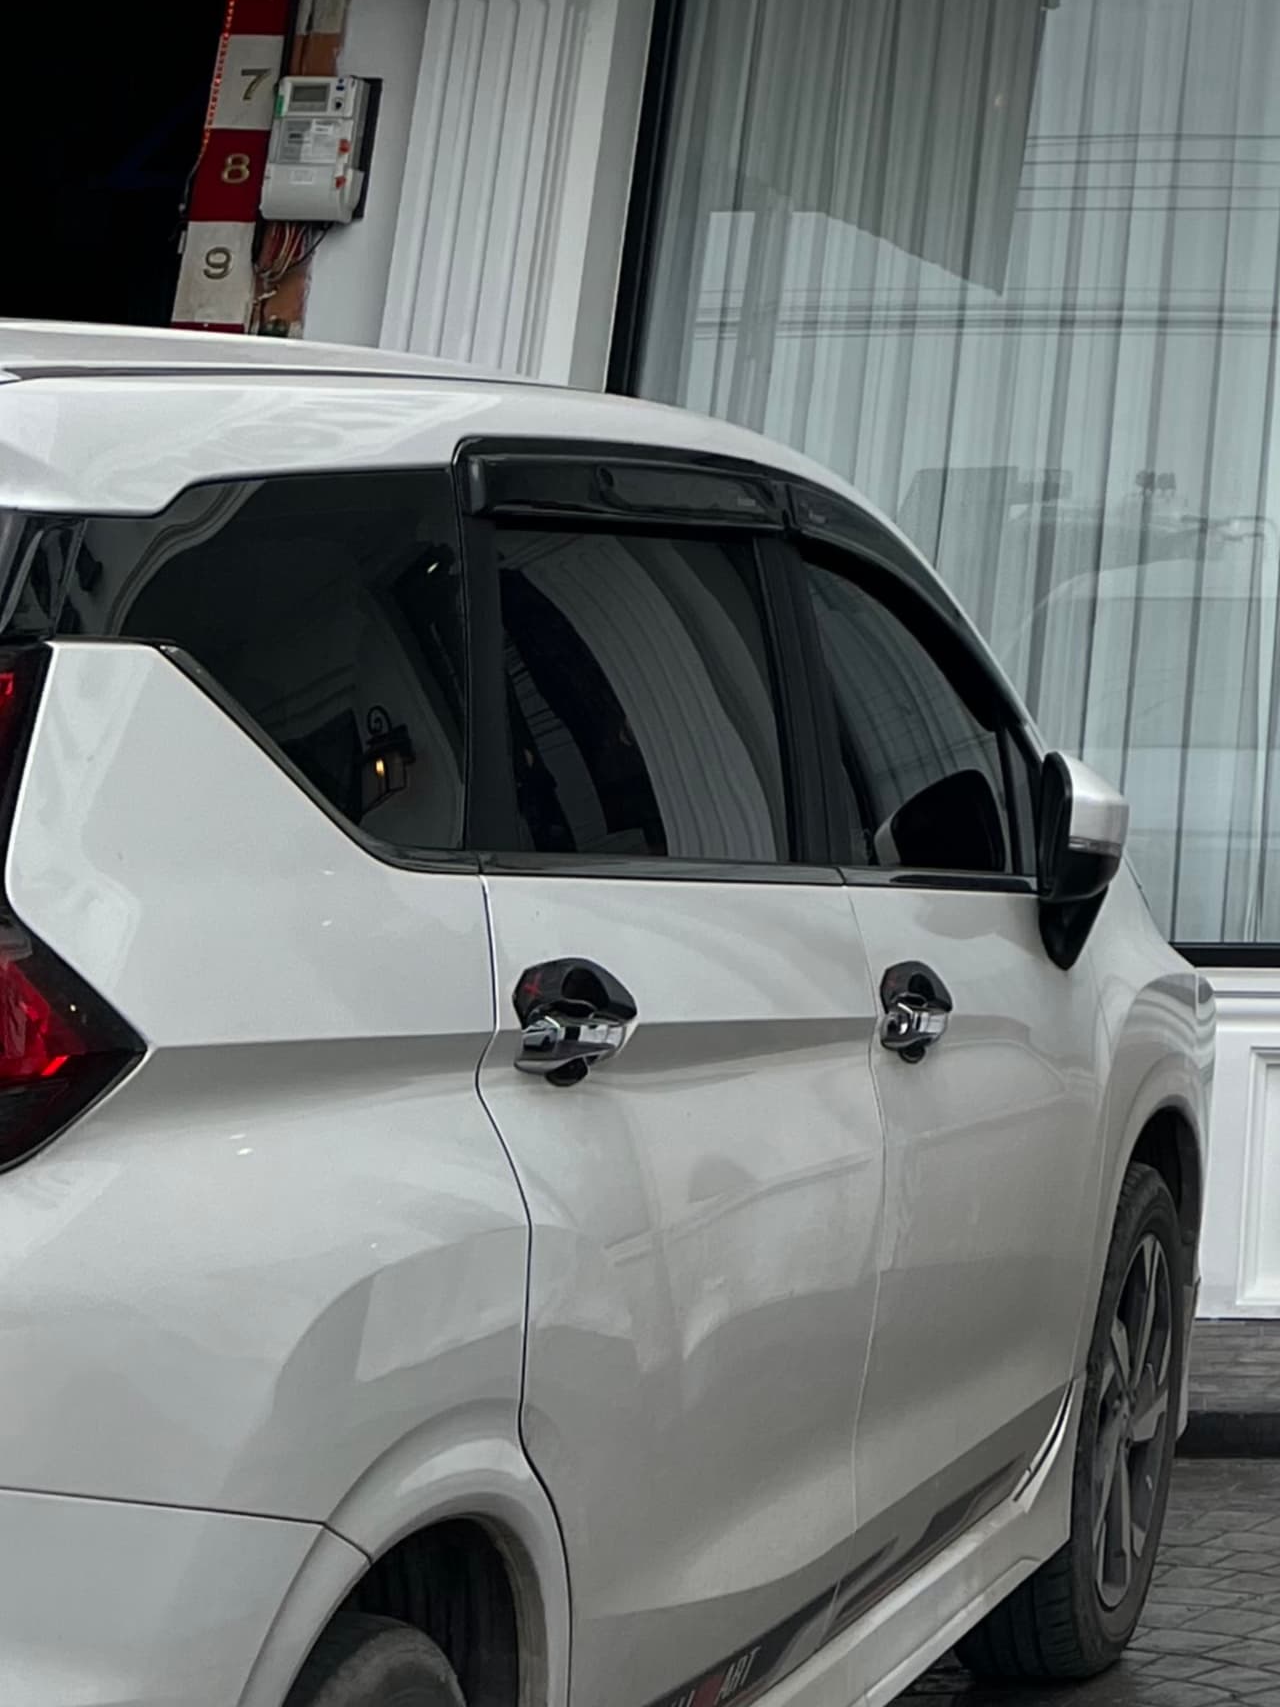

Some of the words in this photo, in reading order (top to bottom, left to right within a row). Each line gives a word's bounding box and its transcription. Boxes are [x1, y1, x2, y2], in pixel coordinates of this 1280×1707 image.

[240, 68, 272, 101] 7
[221, 153, 251, 184] 8
[202, 247, 233, 279] 9
